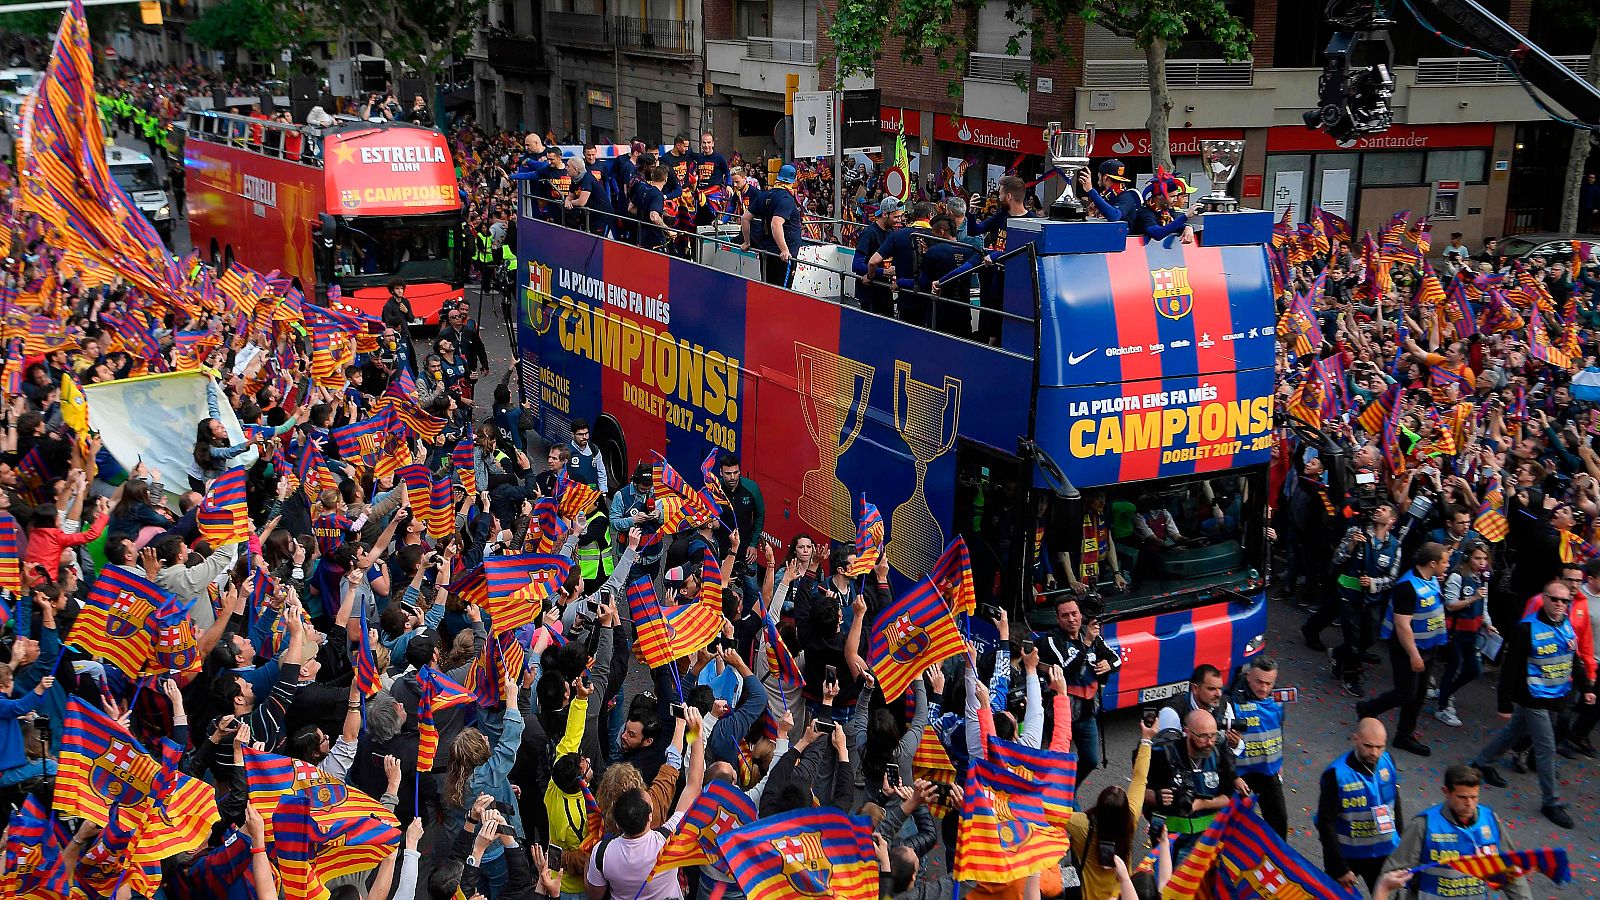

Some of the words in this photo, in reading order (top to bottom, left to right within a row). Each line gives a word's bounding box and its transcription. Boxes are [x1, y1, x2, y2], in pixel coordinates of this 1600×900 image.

[974, 128, 1021, 149] Santander
[1360, 132, 1428, 148] Santander
[361, 147, 446, 164] ESTRELLA
[244, 174, 277, 208] ESTRELLA
[364, 185, 455, 203] CAMPIONS!
[559, 268, 570, 290] LA
[572, 272, 606, 302] PILOTA
[607, 284, 628, 308] ENS
[629, 291, 644, 316] FA
[645, 294, 670, 325] MÉS
[558, 296, 740, 423] CAMPIONS!
[1112, 345, 1142, 356] Rakuten
[540, 366, 555, 388] MÉS
[556, 374, 570, 396] QUE
[542, 386, 552, 404] UN
[552, 392, 570, 414] CLUB
[1070, 401, 1089, 417] LA
[1091, 396, 1140, 415] PILOTA
[1142, 392, 1168, 409] ENS
[1170, 390, 1188, 404] FA
[1188, 383, 1218, 402] MÉS
[623, 381, 665, 419] DOBLET
[665, 402, 694, 433] 2017
[705, 418, 736, 453] 2018
[1069, 394, 1274, 458] CAMPIONS!
[1162, 446, 1212, 464] DOBLET
[1212, 440, 1242, 458] 2017
[1144, 688, 1167, 700] 6248
[112, 766, 135, 784] FCB
[310, 778, 330, 786] FCB
